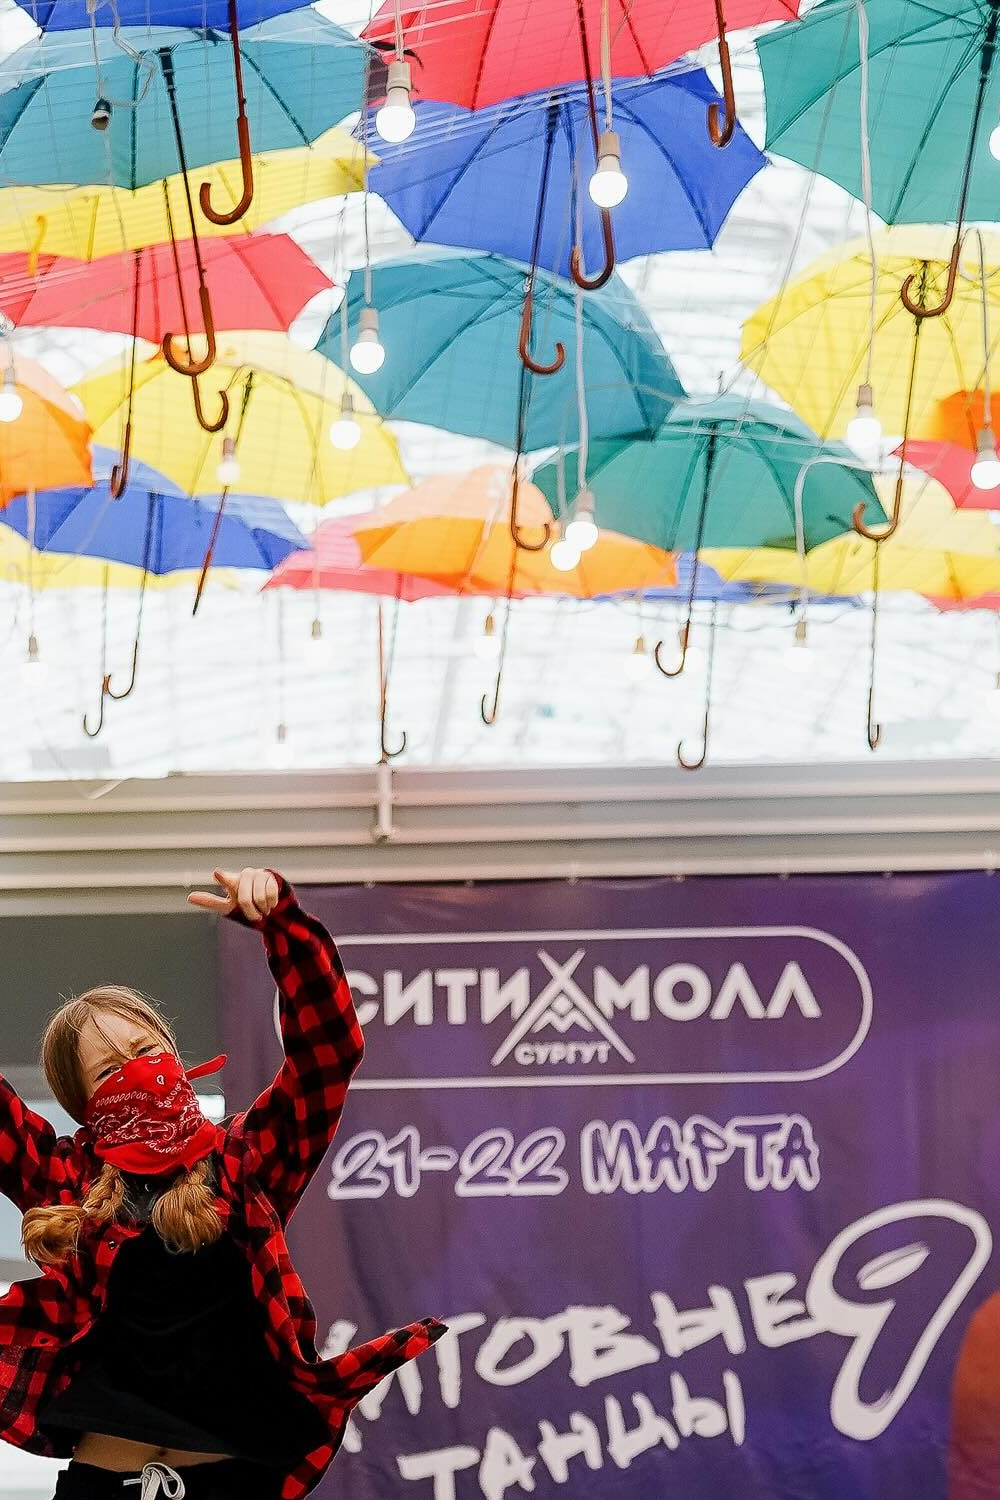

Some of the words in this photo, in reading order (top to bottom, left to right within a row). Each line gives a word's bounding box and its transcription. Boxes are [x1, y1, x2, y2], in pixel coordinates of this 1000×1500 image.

[344, 966, 530, 1026] СИТИ
[592, 961, 823, 1023] МОЛЛ
[513, 1040, 613, 1067] СУРГУТ
[327, 1126, 570, 1200] 21-22
[580, 1113, 821, 1194] МАРТА
[320, 1272, 808, 1453] ТОВЫЕ
